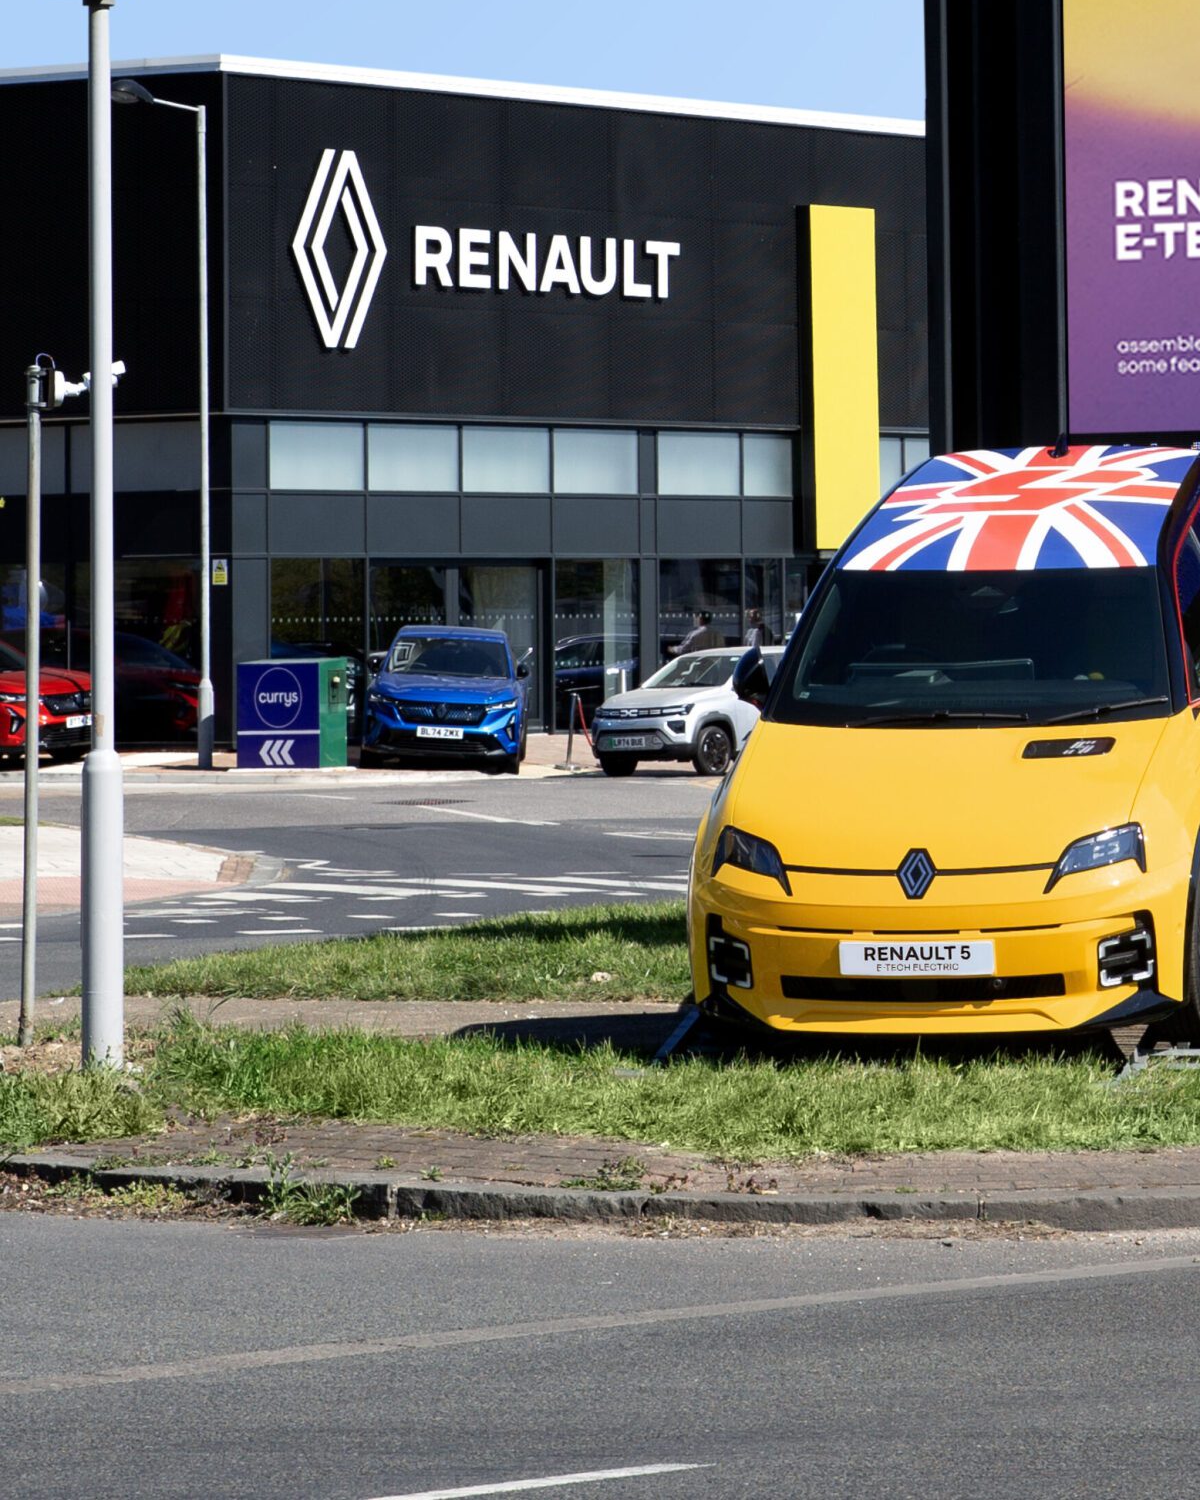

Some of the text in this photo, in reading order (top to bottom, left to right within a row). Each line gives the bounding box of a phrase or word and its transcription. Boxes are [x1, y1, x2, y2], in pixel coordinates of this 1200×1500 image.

[415, 225, 680, 298] RENAULT
[1117, 359, 1168, 374] some
[258, 691, 299, 707] currys
[863, 945, 971, 961] RENAULT 5
[876, 962, 960, 972] E-TECH ELECTRIC
